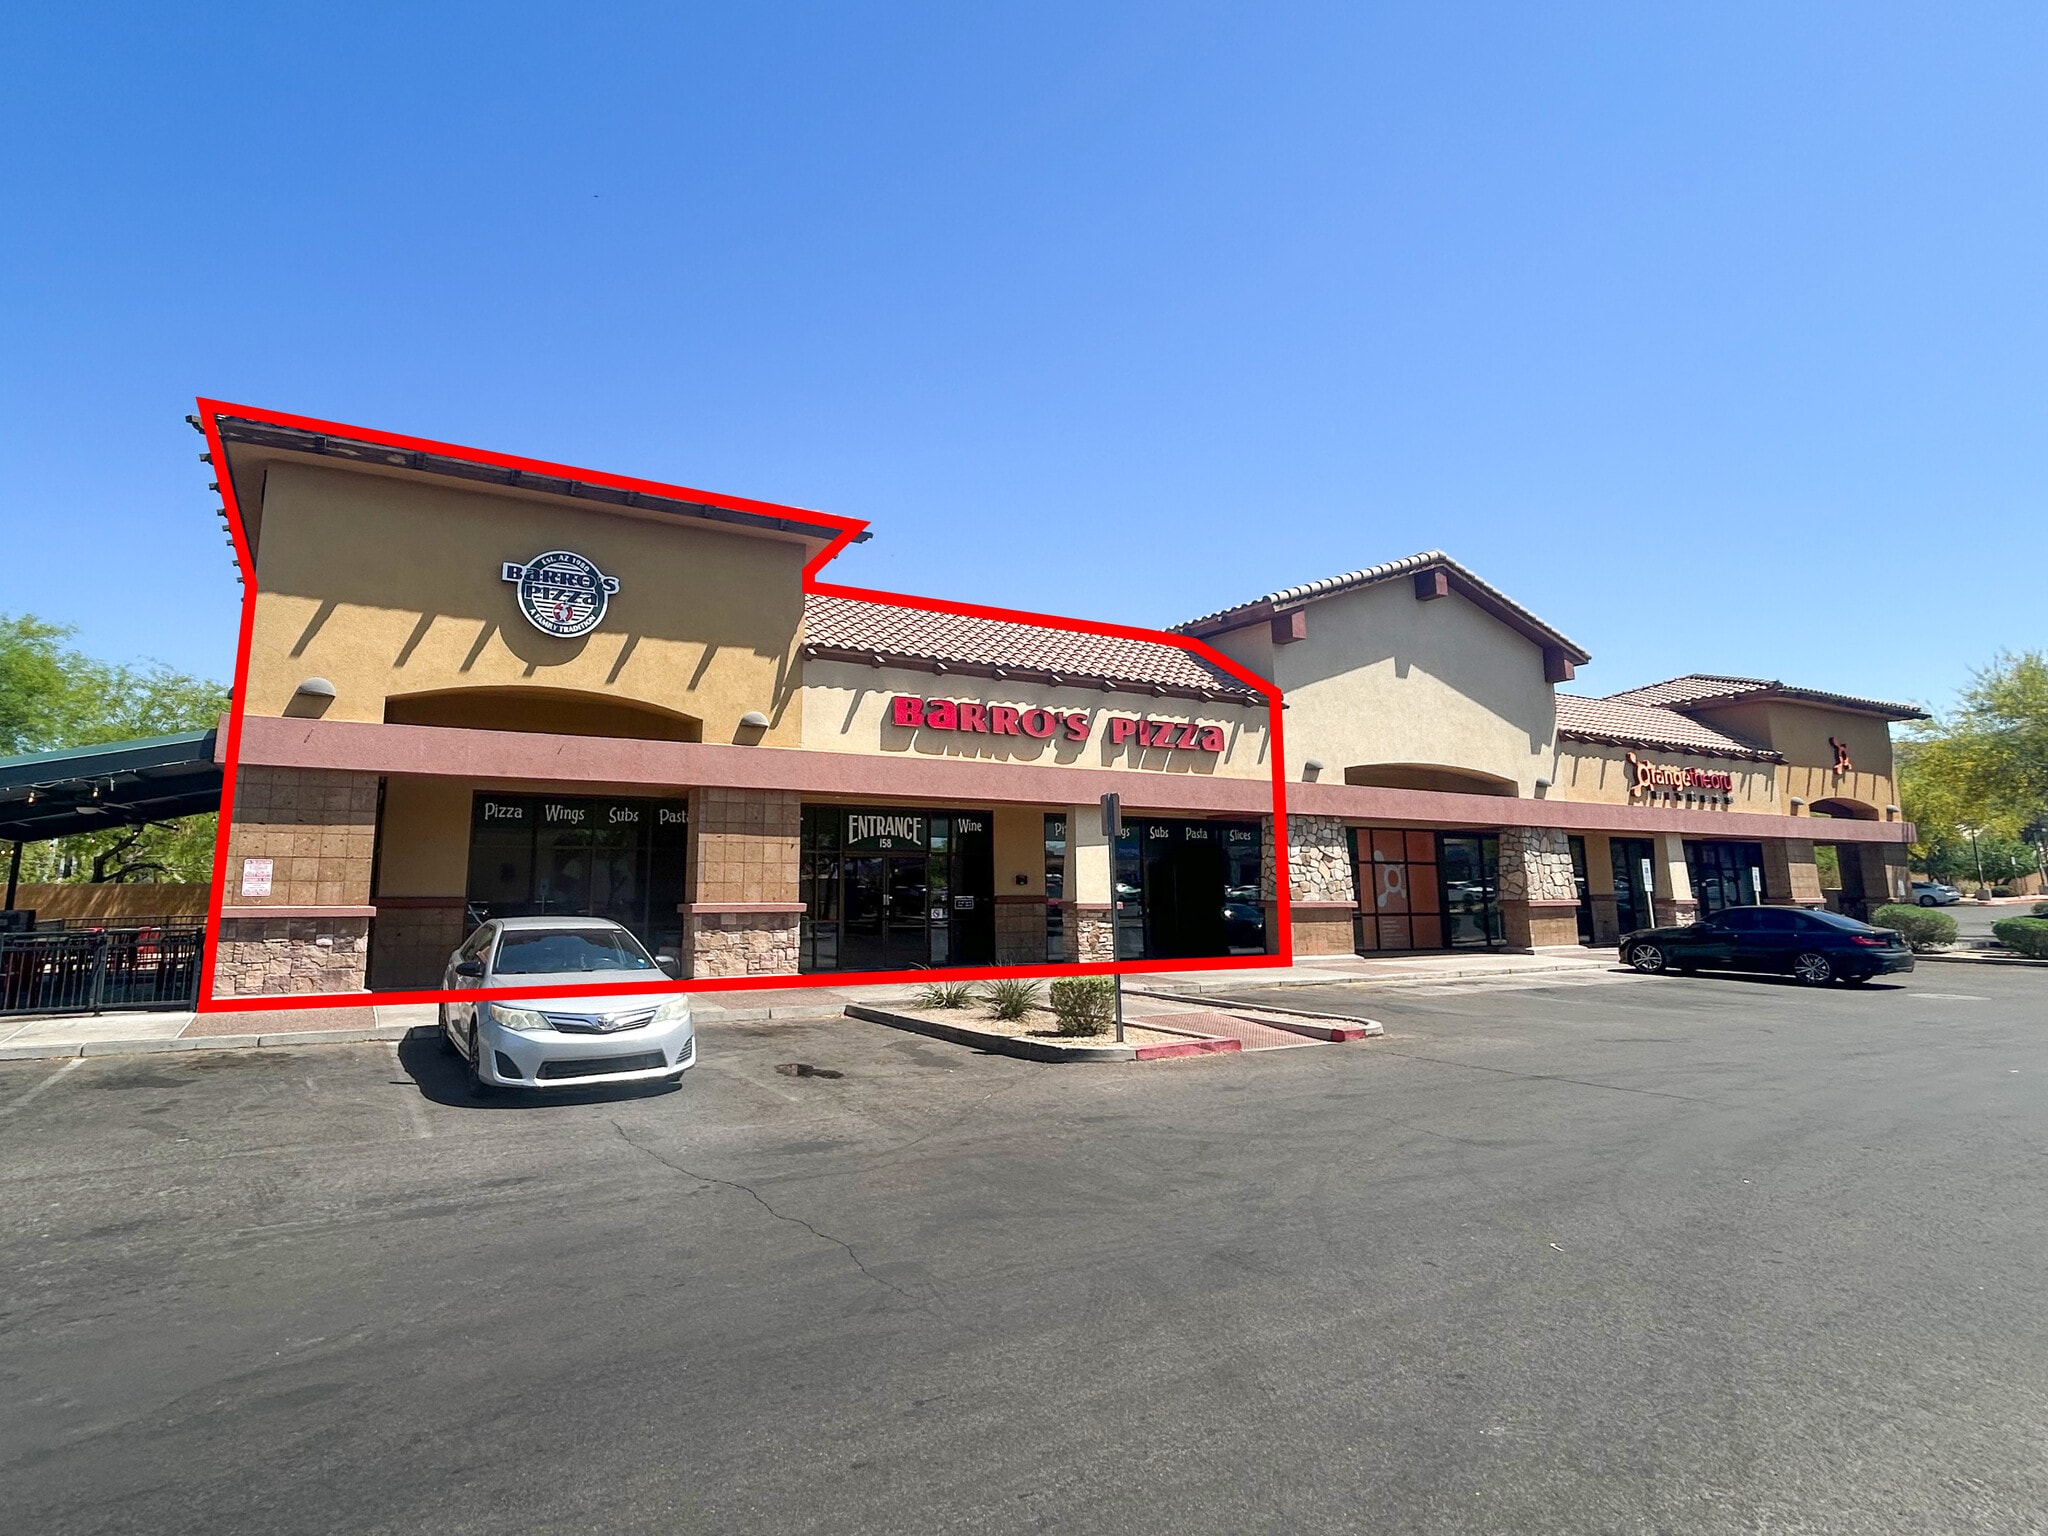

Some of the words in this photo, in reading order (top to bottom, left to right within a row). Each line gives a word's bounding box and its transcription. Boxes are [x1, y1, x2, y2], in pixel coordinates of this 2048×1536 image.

[572, 557, 590, 572] 1980
[533, 612, 557, 631] FAMILY
[559, 614, 596, 633] TRADITION
[484, 802, 523, 820] Pizza
[545, 804, 585, 824] Wings
[608, 807, 639, 823] Subs
[659, 808, 689, 825] Past
[848, 814, 922, 846] ENTRANCE
[958, 818, 982, 834] Wine
[1149, 826, 1169, 839] Subs
[1185, 827, 1208, 841] Pasta
[1229, 829, 1252, 842] Slices
[879, 838, 892, 849] 158
